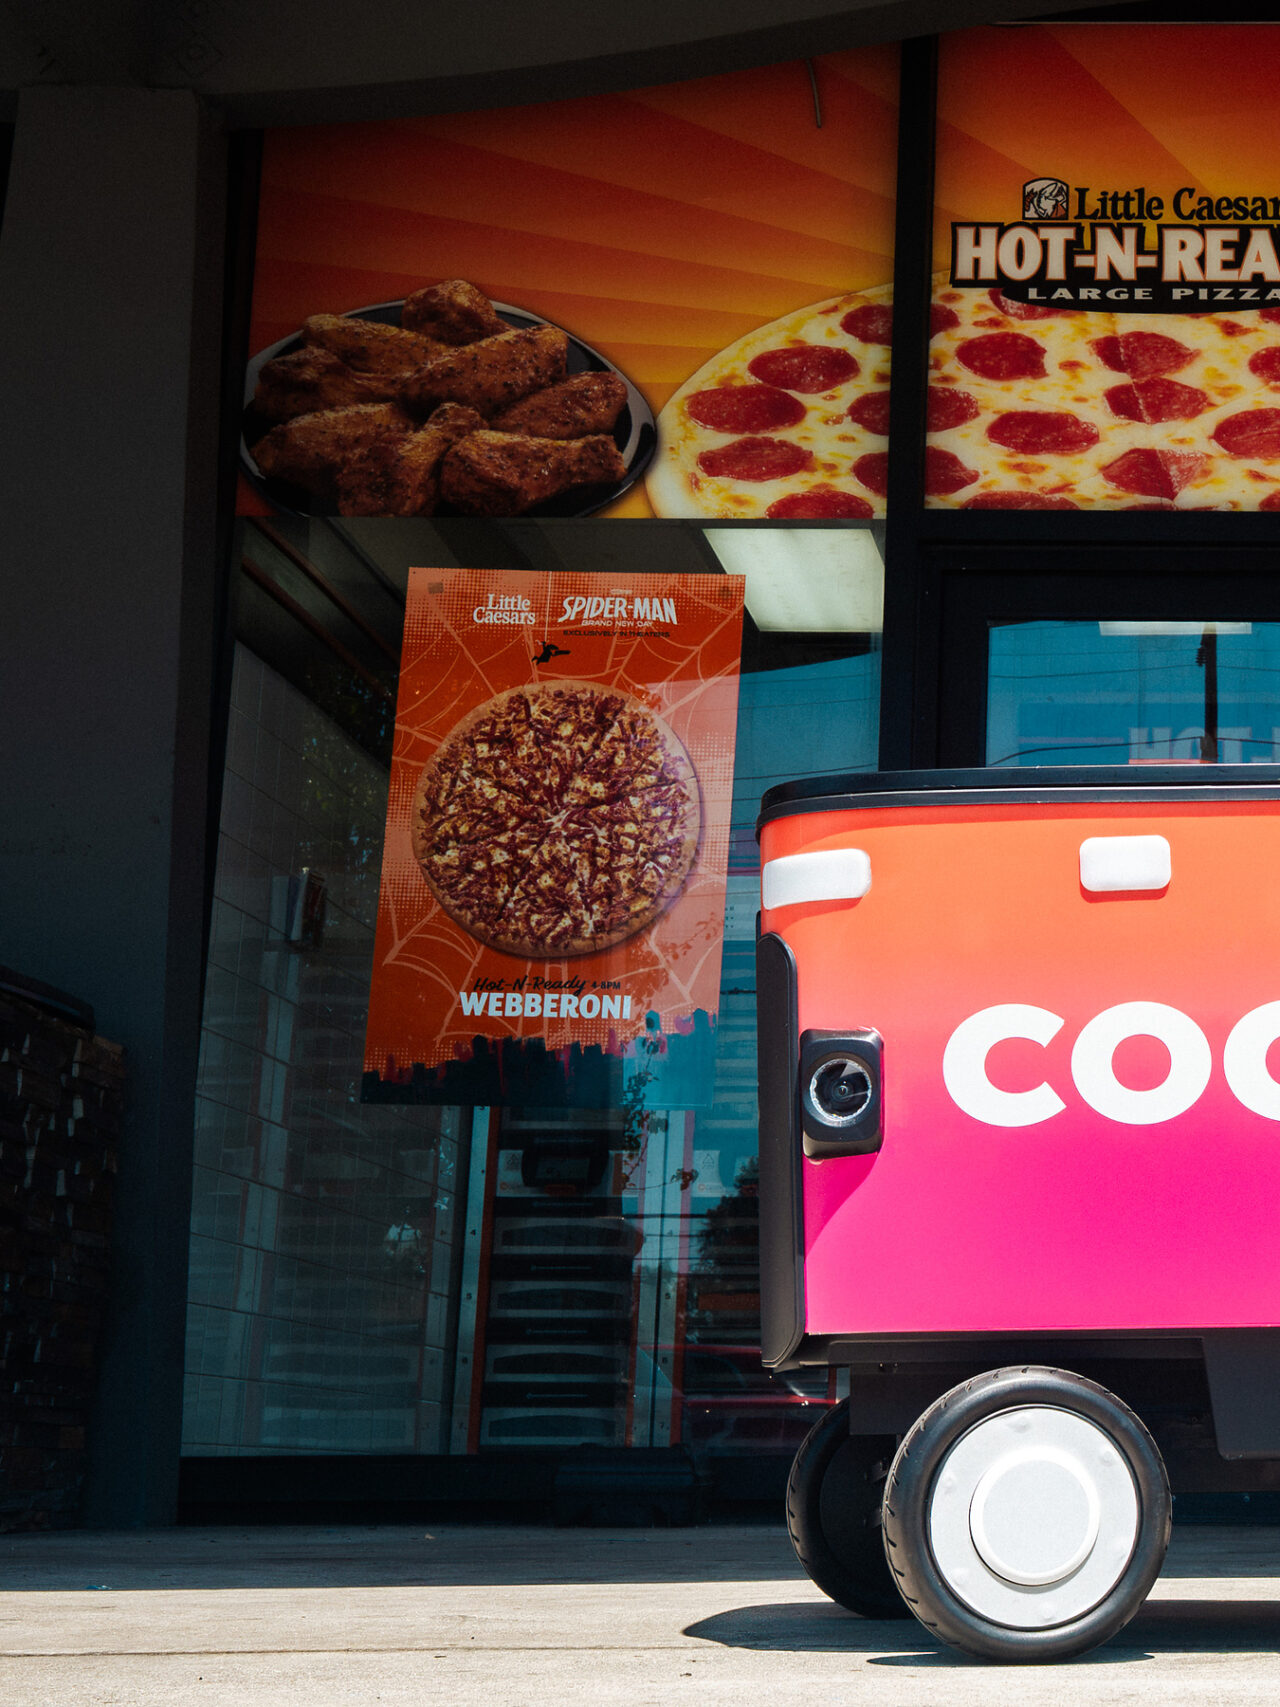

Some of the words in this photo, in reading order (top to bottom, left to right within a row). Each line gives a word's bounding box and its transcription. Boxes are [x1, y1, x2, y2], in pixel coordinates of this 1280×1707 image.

[1075, 187, 1164, 221] Little
[1027, 287, 1153, 301] LARGE
[487, 593, 531, 612] Little
[556, 596, 679, 626] SPIDER-MAN
[472, 606, 536, 625] Caesars
[615, 620, 634, 628] NEW
[629, 631, 671, 639] THEATERS
[473, 975, 586, 997] Hot-N-Ready
[459, 991, 632, 1020] WEBBERONI
